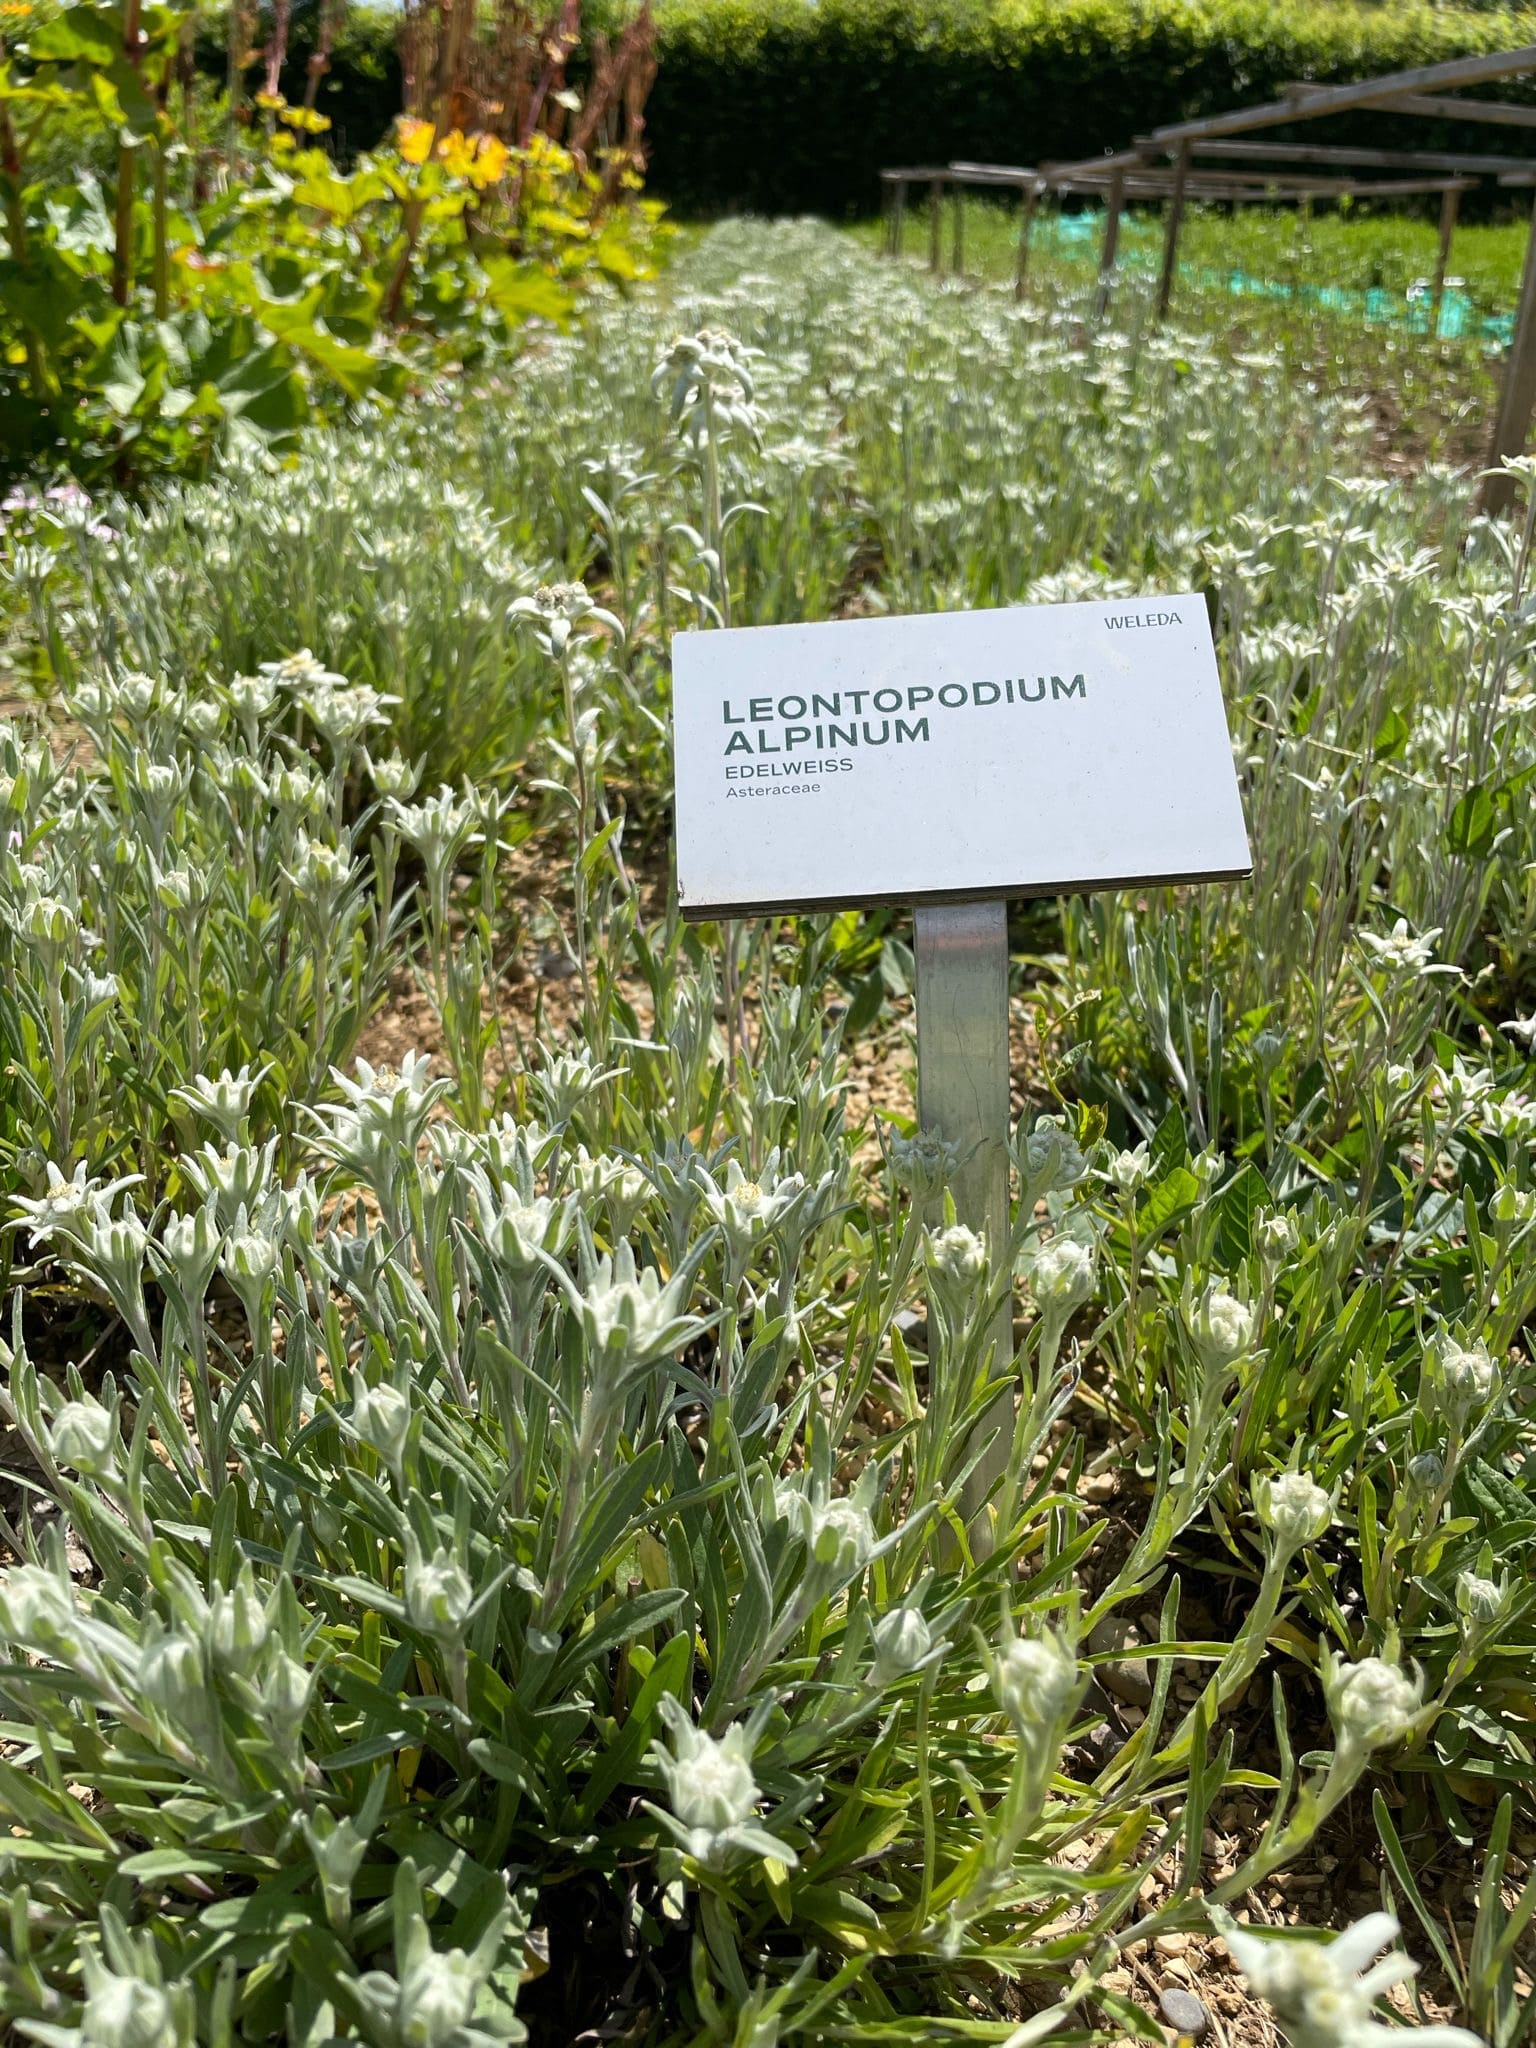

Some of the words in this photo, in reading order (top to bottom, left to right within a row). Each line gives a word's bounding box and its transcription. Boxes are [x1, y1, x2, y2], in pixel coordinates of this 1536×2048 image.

[1103, 612, 1183, 630] WELEDA
[723, 674, 1087, 725] LEONTOPODIUM
[723, 717, 930, 756] ALPINUM
[725, 758, 854, 780] EDELWEISS
[726, 782, 821, 799] Asteraceae
